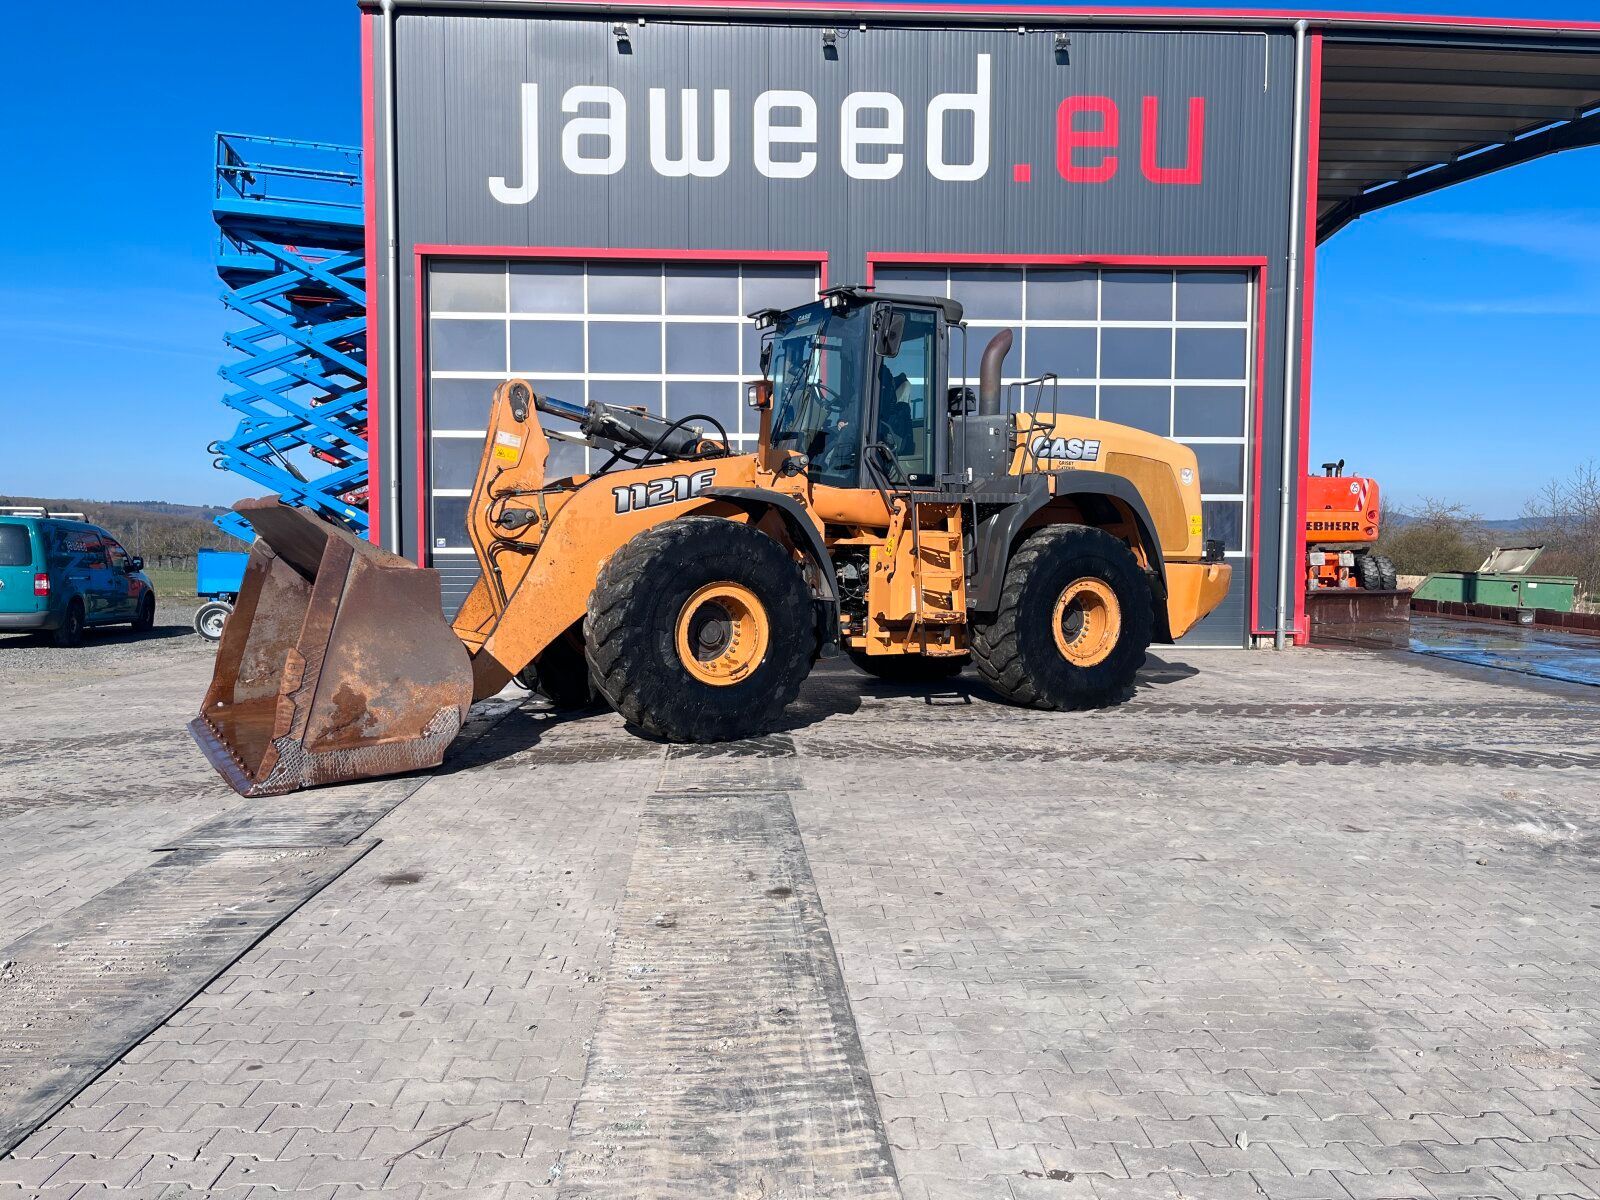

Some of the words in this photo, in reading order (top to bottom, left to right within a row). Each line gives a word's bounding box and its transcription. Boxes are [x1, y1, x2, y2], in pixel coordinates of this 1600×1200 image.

[488, 53, 1205, 204] jaweed.eu
[1031, 436, 1101, 461] CASE
[1351, 483, 1359, 492] 25
[1306, 521, 1360, 531] EBHERR
